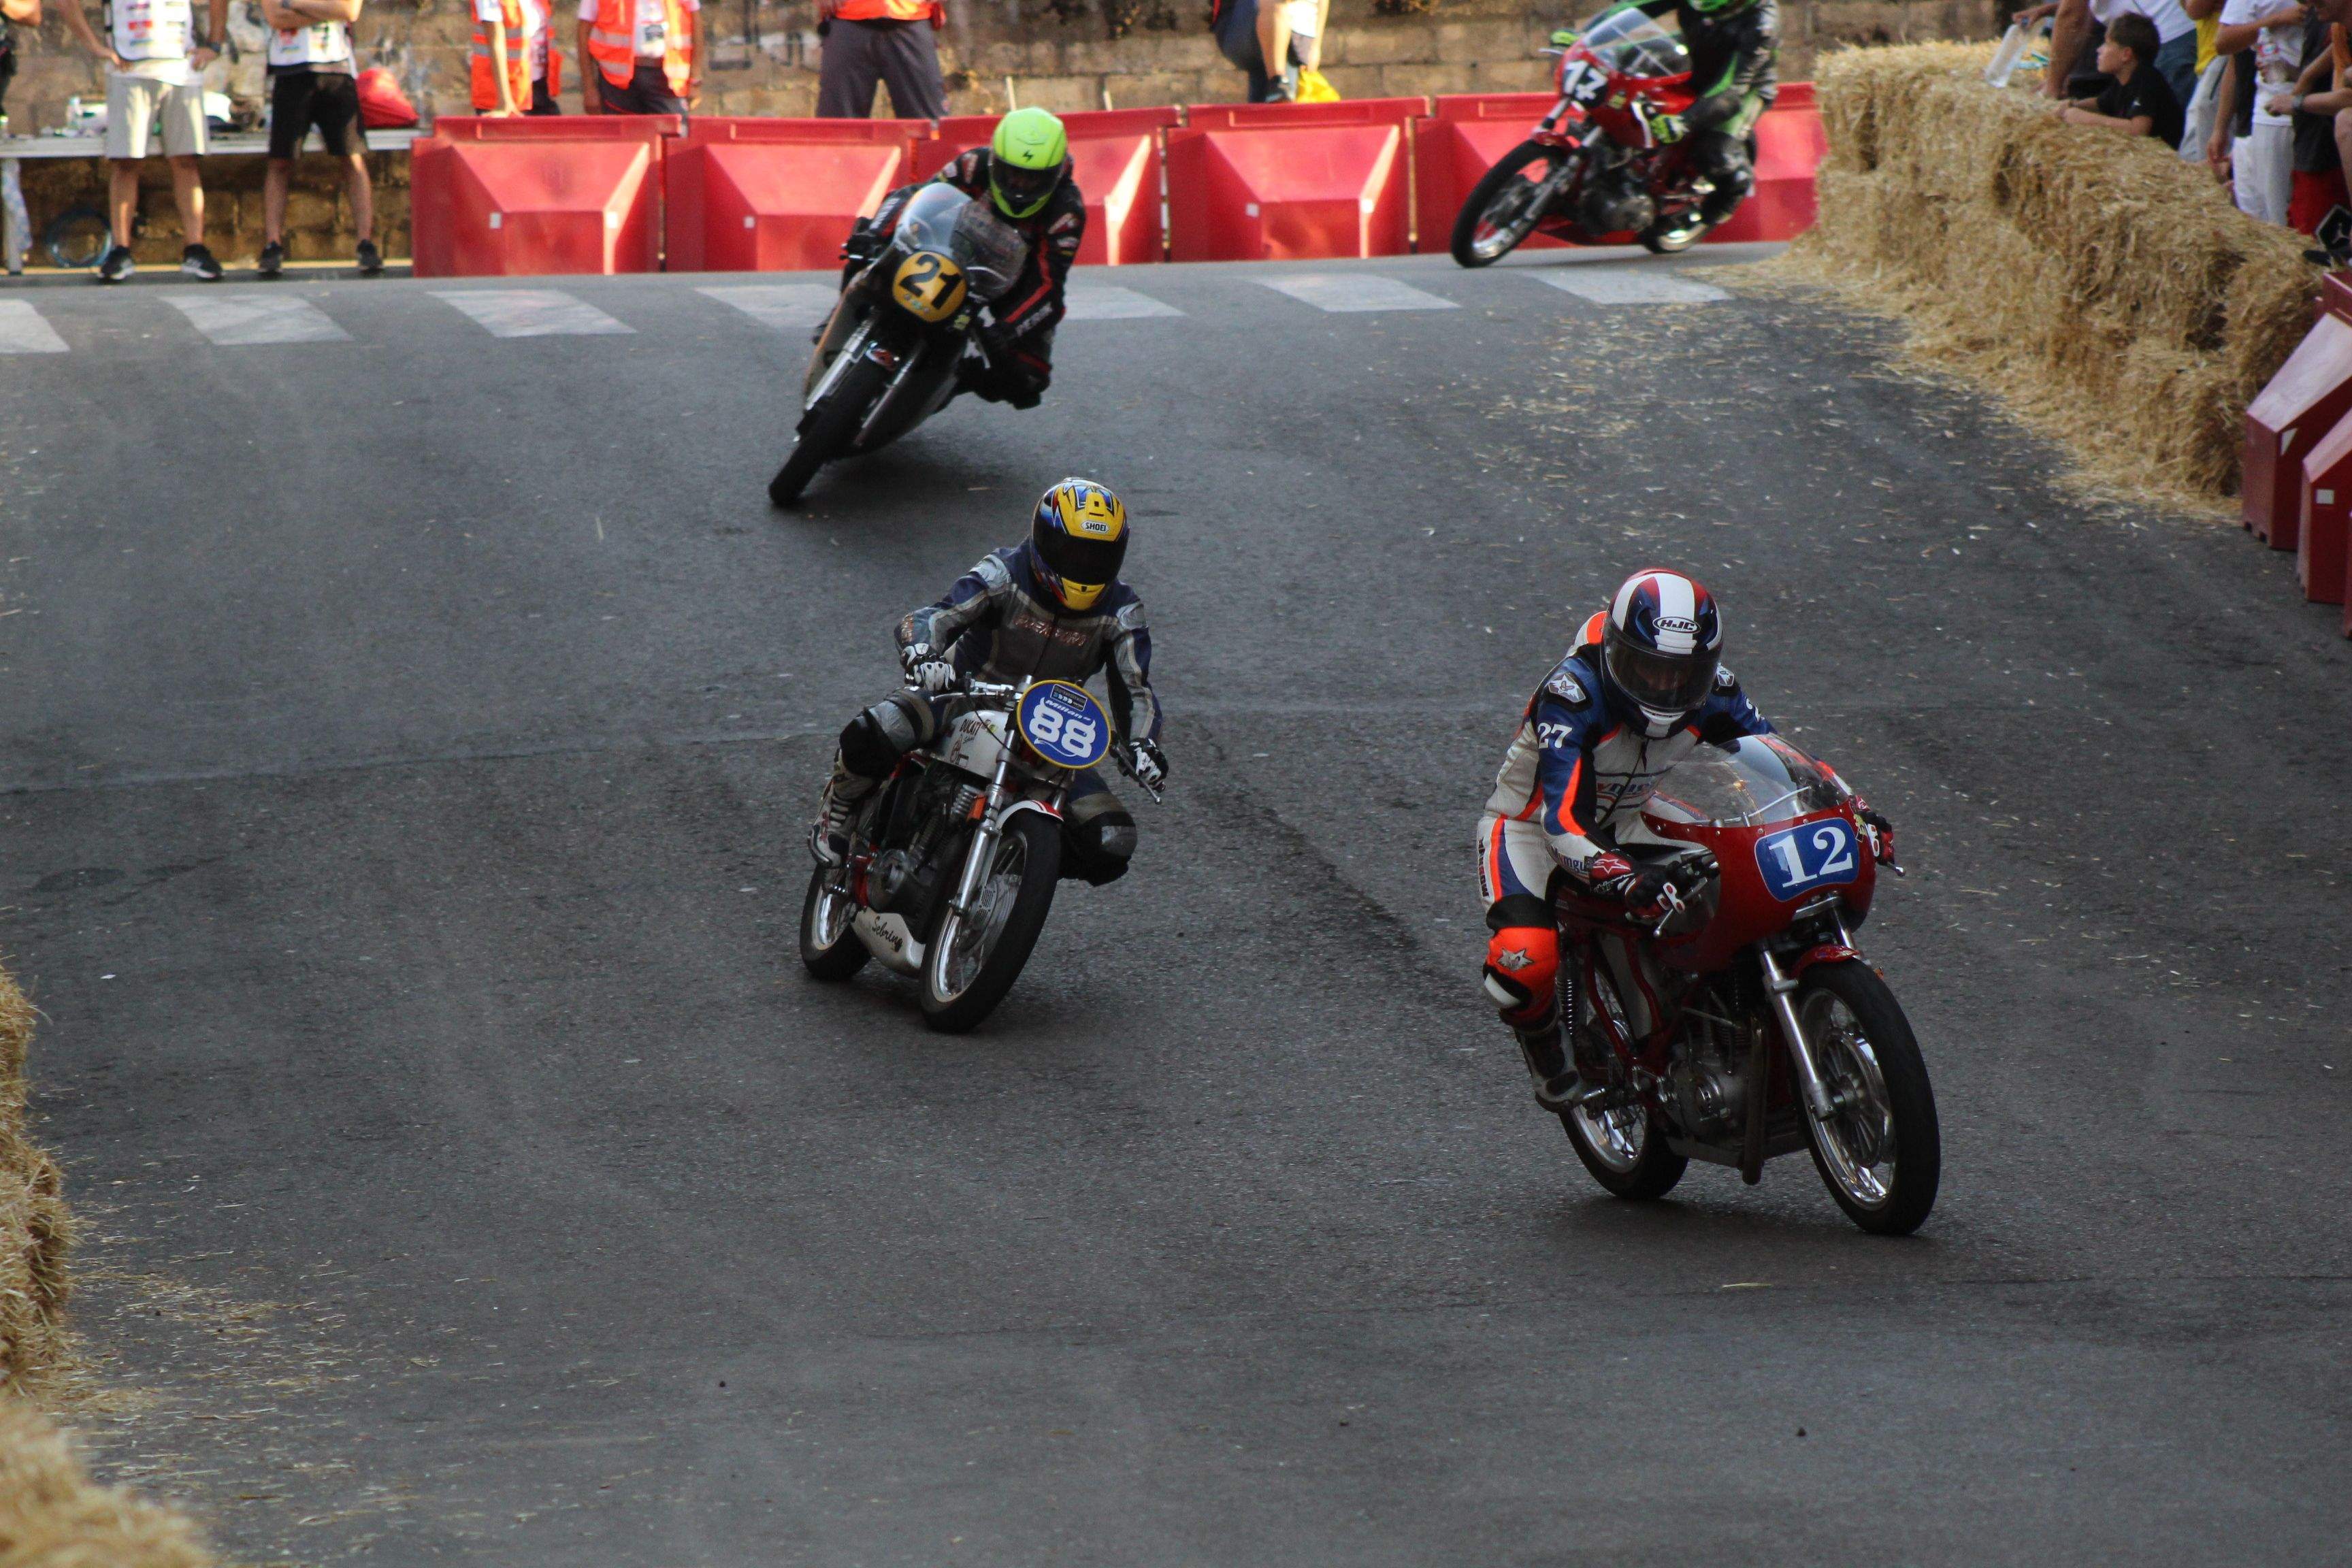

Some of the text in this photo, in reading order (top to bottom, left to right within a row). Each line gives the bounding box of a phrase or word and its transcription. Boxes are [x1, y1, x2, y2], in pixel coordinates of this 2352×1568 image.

[899, 254, 962, 310] 21
[1085, 522, 1107, 532] SHOEI
[1659, 619, 1695, 631] HJC
[1028, 696, 1096, 758] 88
[1537, 722, 1573, 749] 27
[1769, 826, 1854, 888] 12
